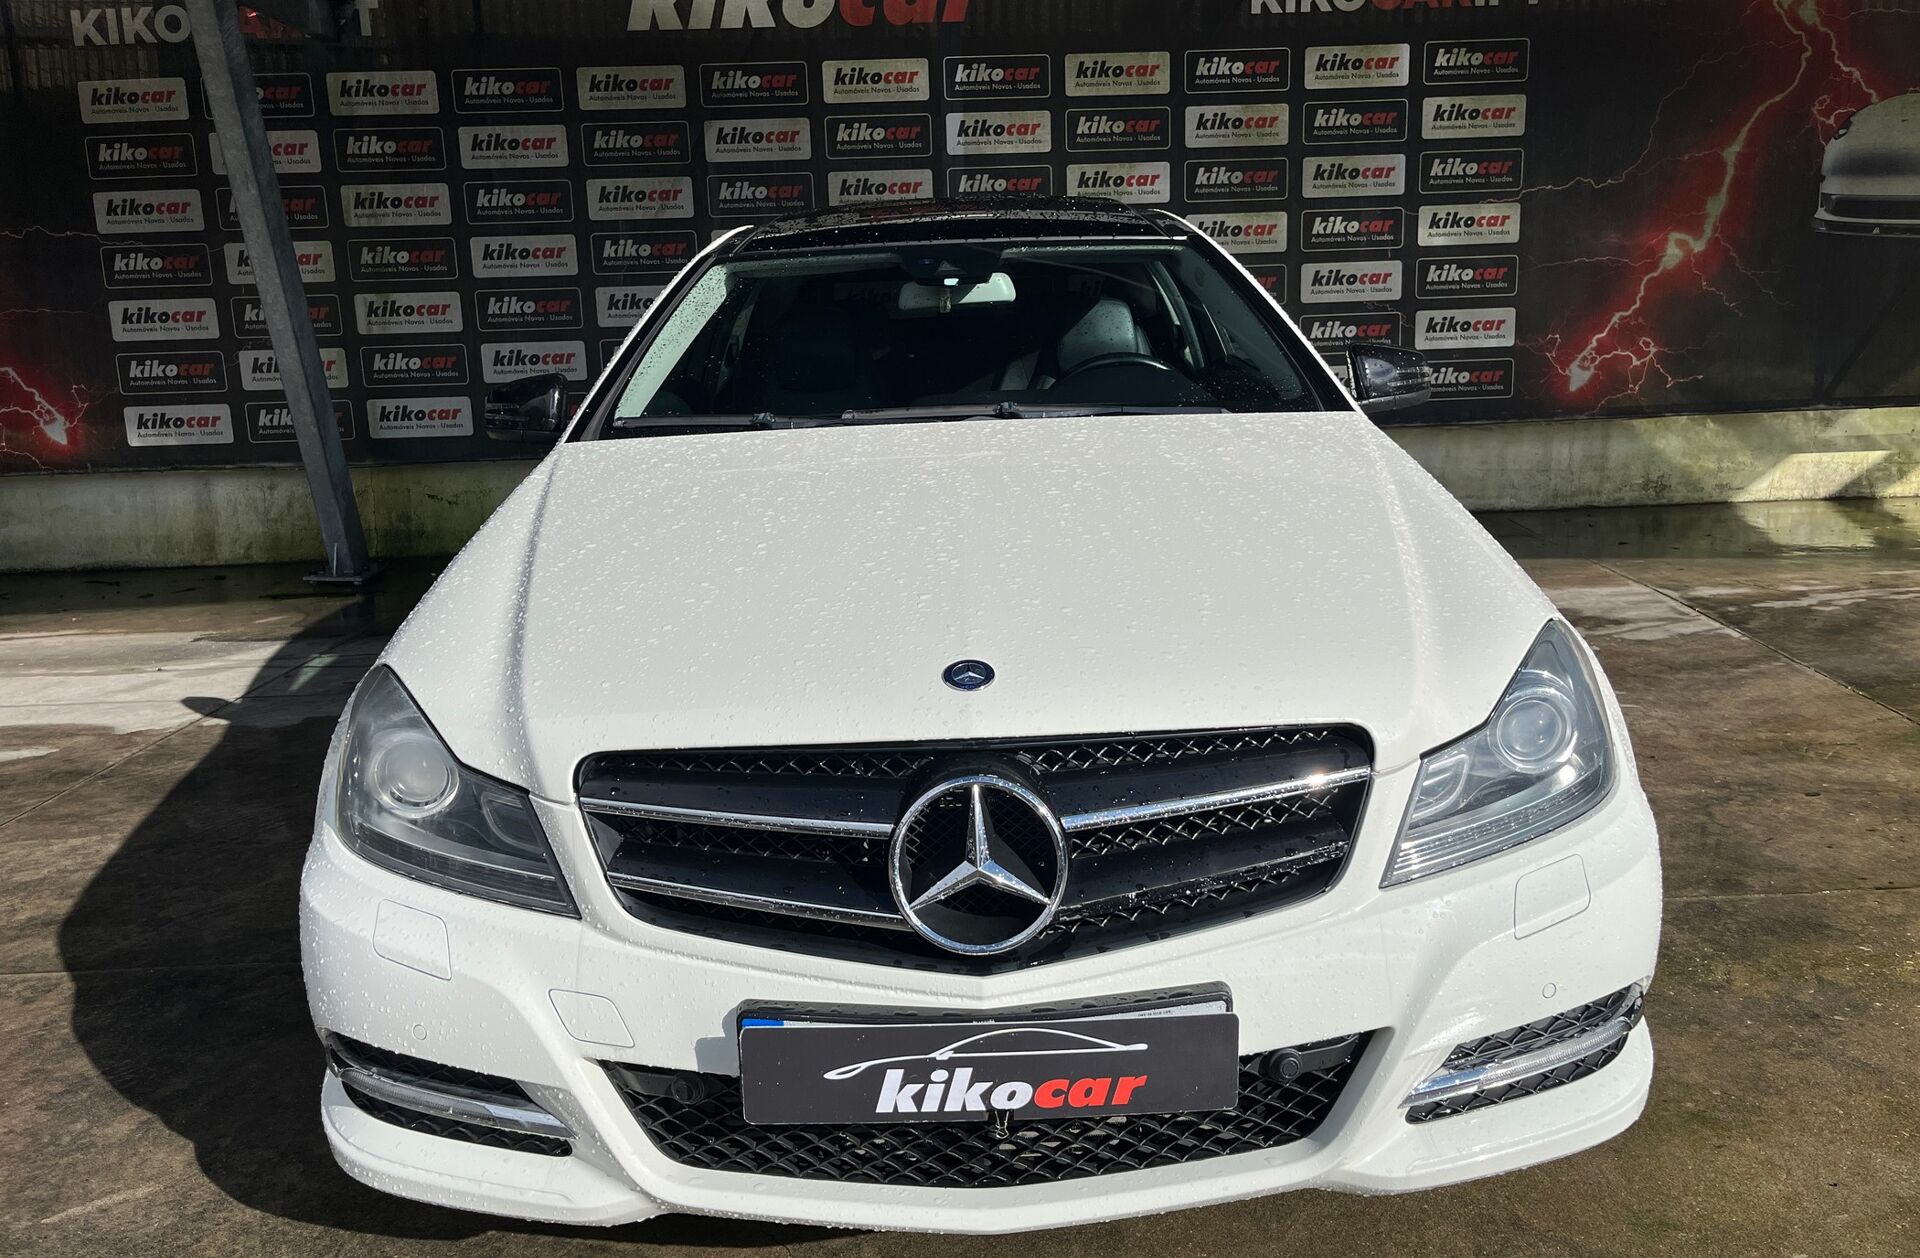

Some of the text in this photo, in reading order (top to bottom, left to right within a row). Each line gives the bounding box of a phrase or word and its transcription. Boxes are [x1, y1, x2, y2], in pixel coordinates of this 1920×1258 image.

[1196, 57, 1279, 75] kikocar
[1316, 53, 1398, 71] kikocar
[1435, 48, 1518, 66] kikocar
[834, 67, 918, 85] kikocar
[955, 63, 1039, 82] kikocar
[1076, 60, 1160, 78] kikocar
[340, 79, 426, 97] kikocar
[465, 77, 551, 95] kikocar
[589, 74, 674, 92] kikocar
[712, 71, 797, 89] kikocar
[91, 87, 175, 106] kikocar
[1196, 113, 1278, 130] kikocar
[1314, 109, 1397, 126] kikocar
[1433, 104, 1516, 121] kikocar
[837, 123, 920, 141] kikocar
[957, 119, 1040, 137] kikocar
[1077, 116, 1160, 134] kikocar
[347, 136, 432, 154] kikocar
[471, 133, 556, 151] kikocar
[594, 130, 678, 148] kikocar
[716, 127, 800, 145] kikocar
[99, 143, 183, 161] kikocar
[1195, 167, 1278, 184] kikocar
[1313, 163, 1395, 180] kikocar
[1430, 158, 1513, 176] kikocar
[839, 179, 922, 195] kikocar
[959, 174, 1042, 192] kikocar
[1077, 171, 1160, 188] kikocar
[477, 189, 561, 206] kikocar
[599, 185, 682, 203] kikocar
[719, 182, 803, 199] kikocar
[106, 198, 190, 216] kikocar
[354, 192, 439, 209] kikocar
[1312, 216, 1393, 234] kikocar
[1428, 212, 1510, 229] kikocar
[361, 246, 445, 264] kikocar
[483, 243, 566, 261] kikocar
[603, 240, 686, 257] kikocar
[114, 253, 198, 271] kikocar
[1311, 269, 1392, 286] kikocar
[1427, 264, 1508, 281] kikocar
[367, 300, 450, 317] kikocar
[488, 297, 570, 314] kikocar
[122, 307, 206, 324] kikocar
[1425, 316, 1505, 333] kikocar
[1310, 321, 1391, 337] kikocar
[373, 353, 456, 370] kikocar
[493, 349, 575, 367] kikocar
[130, 360, 213, 377] kikocar
[137, 413, 220, 429] kikocar
[379, 405, 461, 422] kikocar
[875, 1067, 1147, 1113] kikocar
